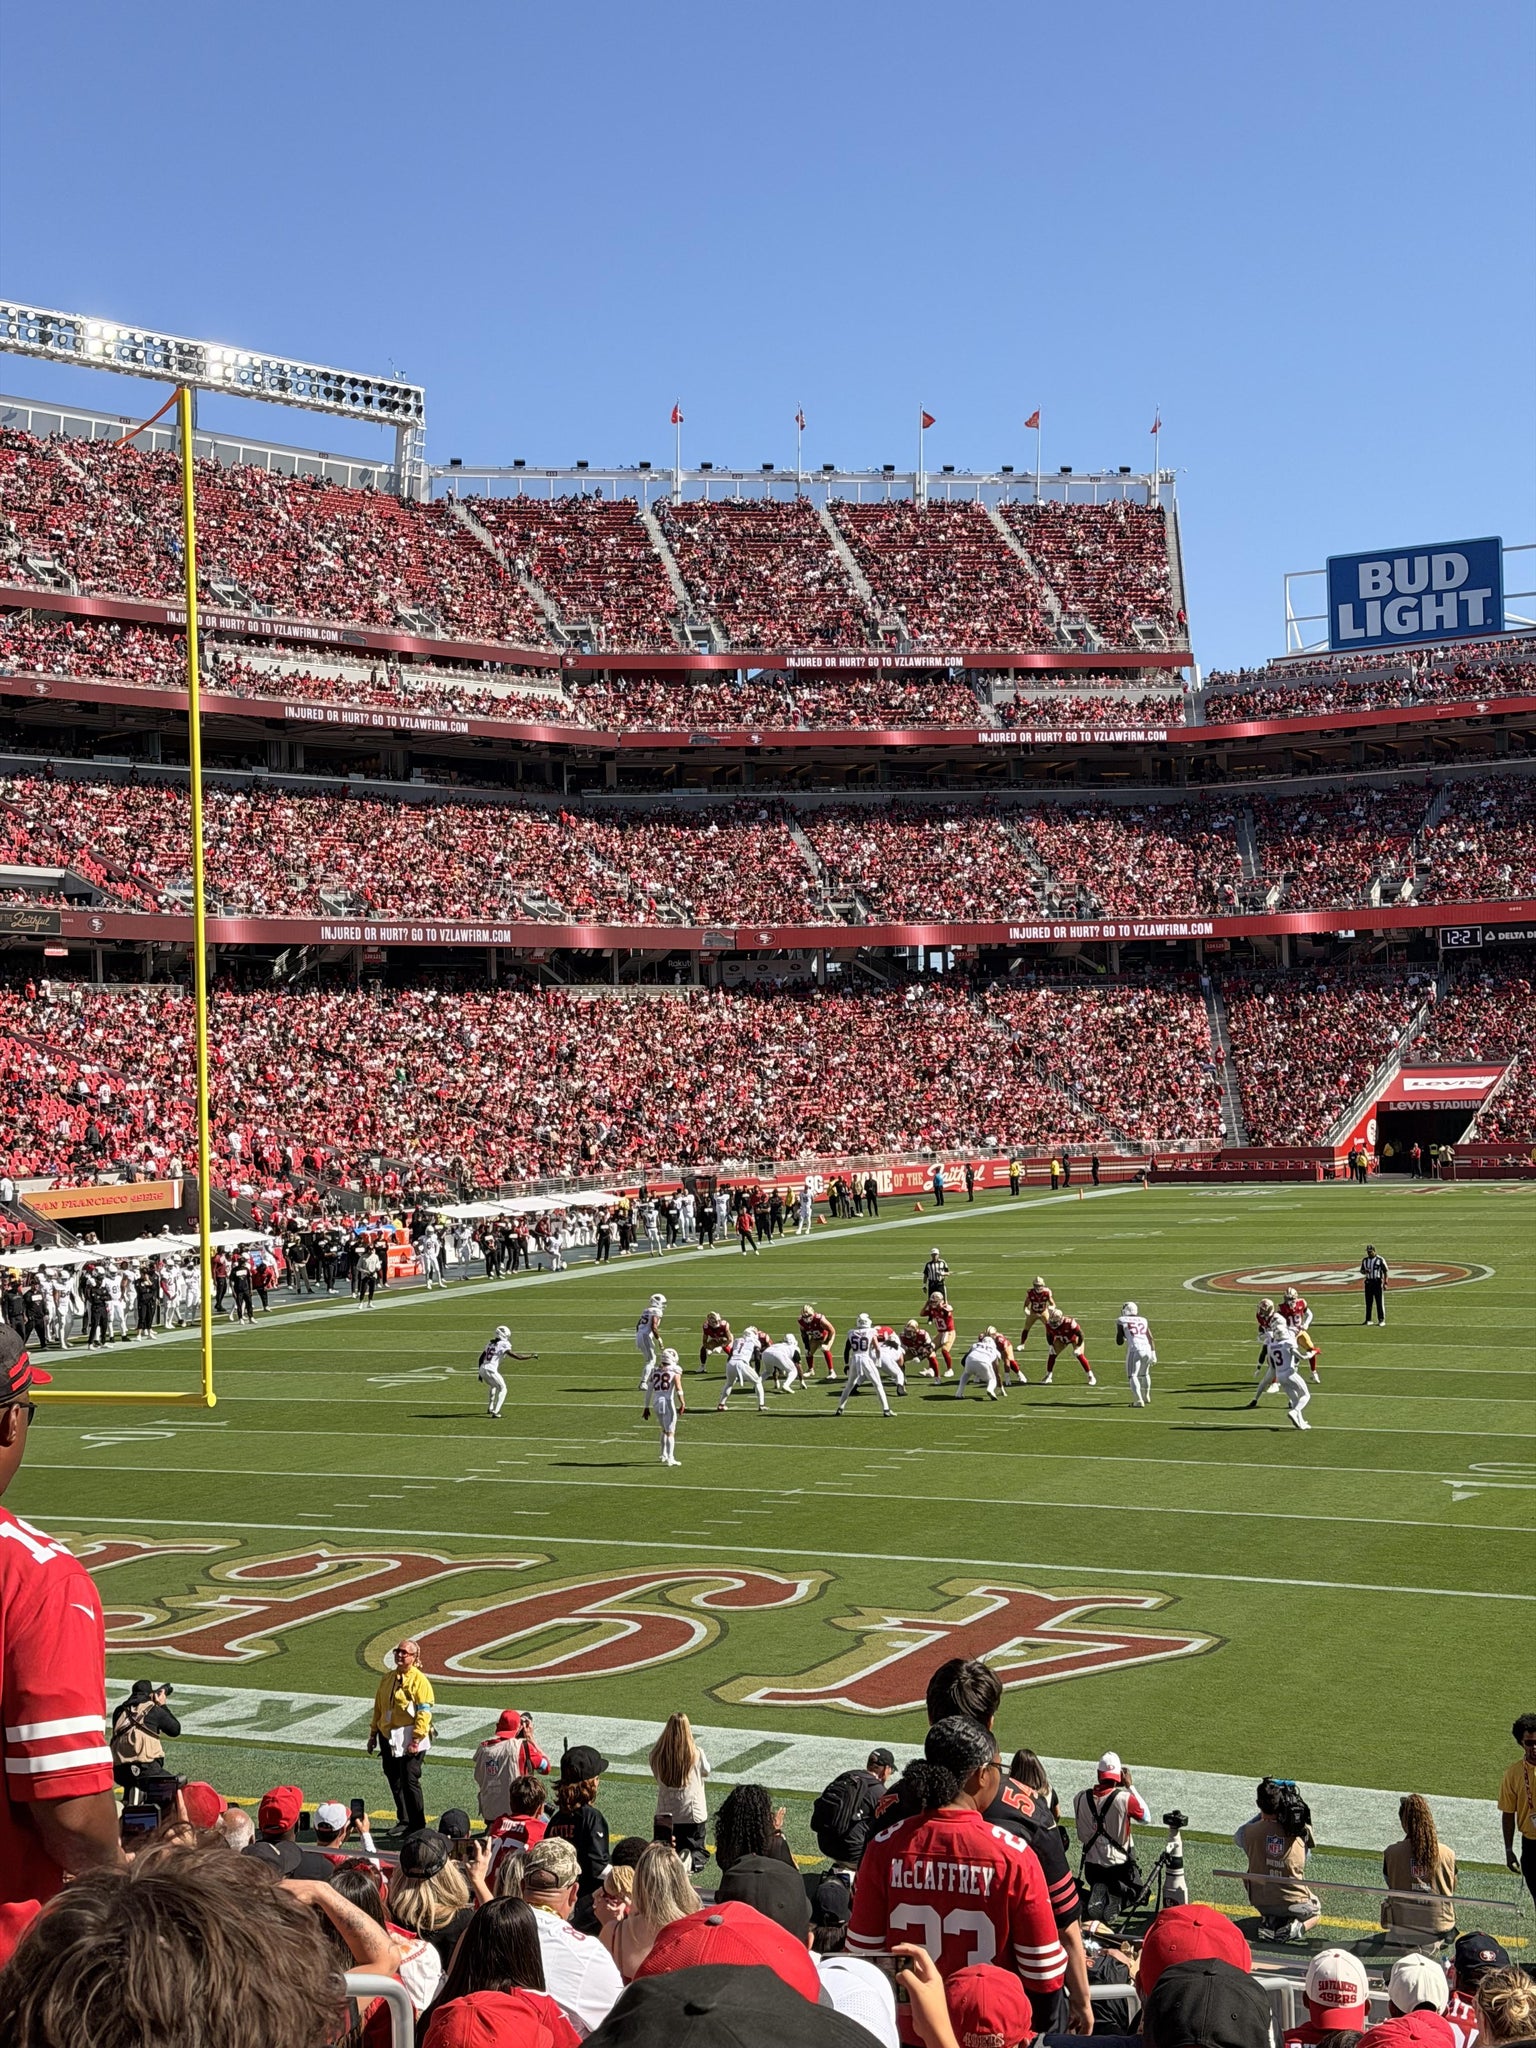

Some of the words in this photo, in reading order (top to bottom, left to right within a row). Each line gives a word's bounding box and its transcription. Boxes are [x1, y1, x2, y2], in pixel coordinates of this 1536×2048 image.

[1358, 552, 1470, 599] BUD
[1338, 587, 1492, 640] LIGHT
[205, 616, 217, 627] OR
[219, 617, 246, 632] HURT?
[247, 621, 259, 632] GO
[260, 622, 271, 634] TO
[273, 623, 339, 642] VZLAWFIRM.COM
[786, 656, 823, 667] INJURED
[825, 656, 837, 667] OR
[839, 656, 866, 667] HURT?
[868, 656, 879, 667] GO
[881, 656, 893, 667] TO
[894, 656, 963, 668] VZLAWFIRM.COM
[284, 705, 324, 720] INJURED
[326, 711, 339, 722] OR
[341, 712, 369, 725] HURT?
[372, 715, 384, 726] GO
[386, 716, 397, 727] TO
[399, 716, 469, 734] VZLAWFIRM.COM
[978, 732, 1017, 743] INJURED
[1019, 732, 1032, 743] OR
[1034, 731, 1062, 743] HURT?
[1065, 731, 1077, 742] GO
[1079, 731, 1091, 742] TO
[1093, 730, 1168, 742] VZLAWFIRM.COM
[11, 911, 51, 932] Faithful
[321, 926, 361, 941] INJURED
[364, 927, 377, 941] OR
[380, 927, 409, 942] HURT?
[411, 928, 423, 942] GO
[425, 928, 437, 942] TO
[439, 928, 512, 943] VZLAWFIRM.COM
[1009, 926, 1050, 939] INJURED
[1053, 926, 1067, 939] OR
[1070, 926, 1100, 938] HURT?
[1103, 925, 1116, 937] GO
[1118, 924, 1130, 937] TO
[1133, 922, 1214, 937] VZLAWFIRM.COM
[1447, 930, 1480, 944] 12:21
[1498, 931, 1525, 940] DELTA
[1432, 1101, 1481, 1110] STADIUM
[894, 1174, 905, 1186] OF
[906, 1172, 924, 1186] THE
[33, 1201, 58, 1211] SAN
[61, 1195, 128, 1209] FRANCISCO
[130, 1192, 164, 1203] 49ERS
[1128, 1322, 1148, 1335] 52
[1288, 1315, 1302, 1326] 19
[851, 1335, 869, 1351] 50
[1273, 1350, 1284, 1367] 3
[652, 1373, 671, 1391] 28
[891, 1857, 995, 1897] McCAFFREY
[1318, 1980, 1329, 1993] SAN
[1329, 1979, 1358, 1994] FRANCISCO
[1318, 1992, 1357, 2004] 49ERS
[962, 2033, 1006, 2048] 49ERS
